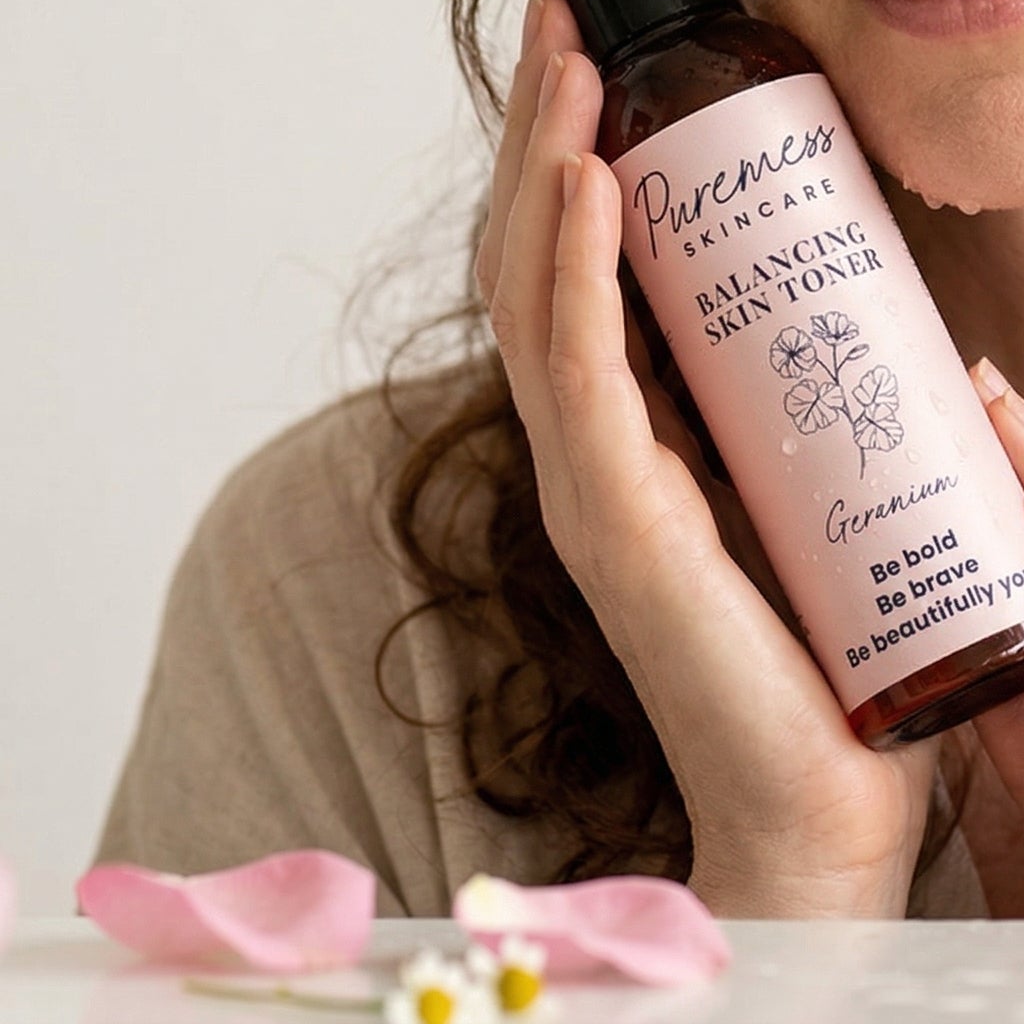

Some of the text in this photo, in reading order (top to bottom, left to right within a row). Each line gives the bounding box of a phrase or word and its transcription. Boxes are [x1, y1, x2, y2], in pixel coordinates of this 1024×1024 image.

[683, 178, 835, 258] SKINCARE
[695, 221, 866, 317] BALANCING
[704, 248, 884, 347] SKIN TONER
[826, 475, 959, 545] Geranium
[869, 529, 959, 585] Be bold
[875, 558, 980, 616] Be brave
[846, 645, 871, 668] Be
[870, 583, 995, 654] beautifully
